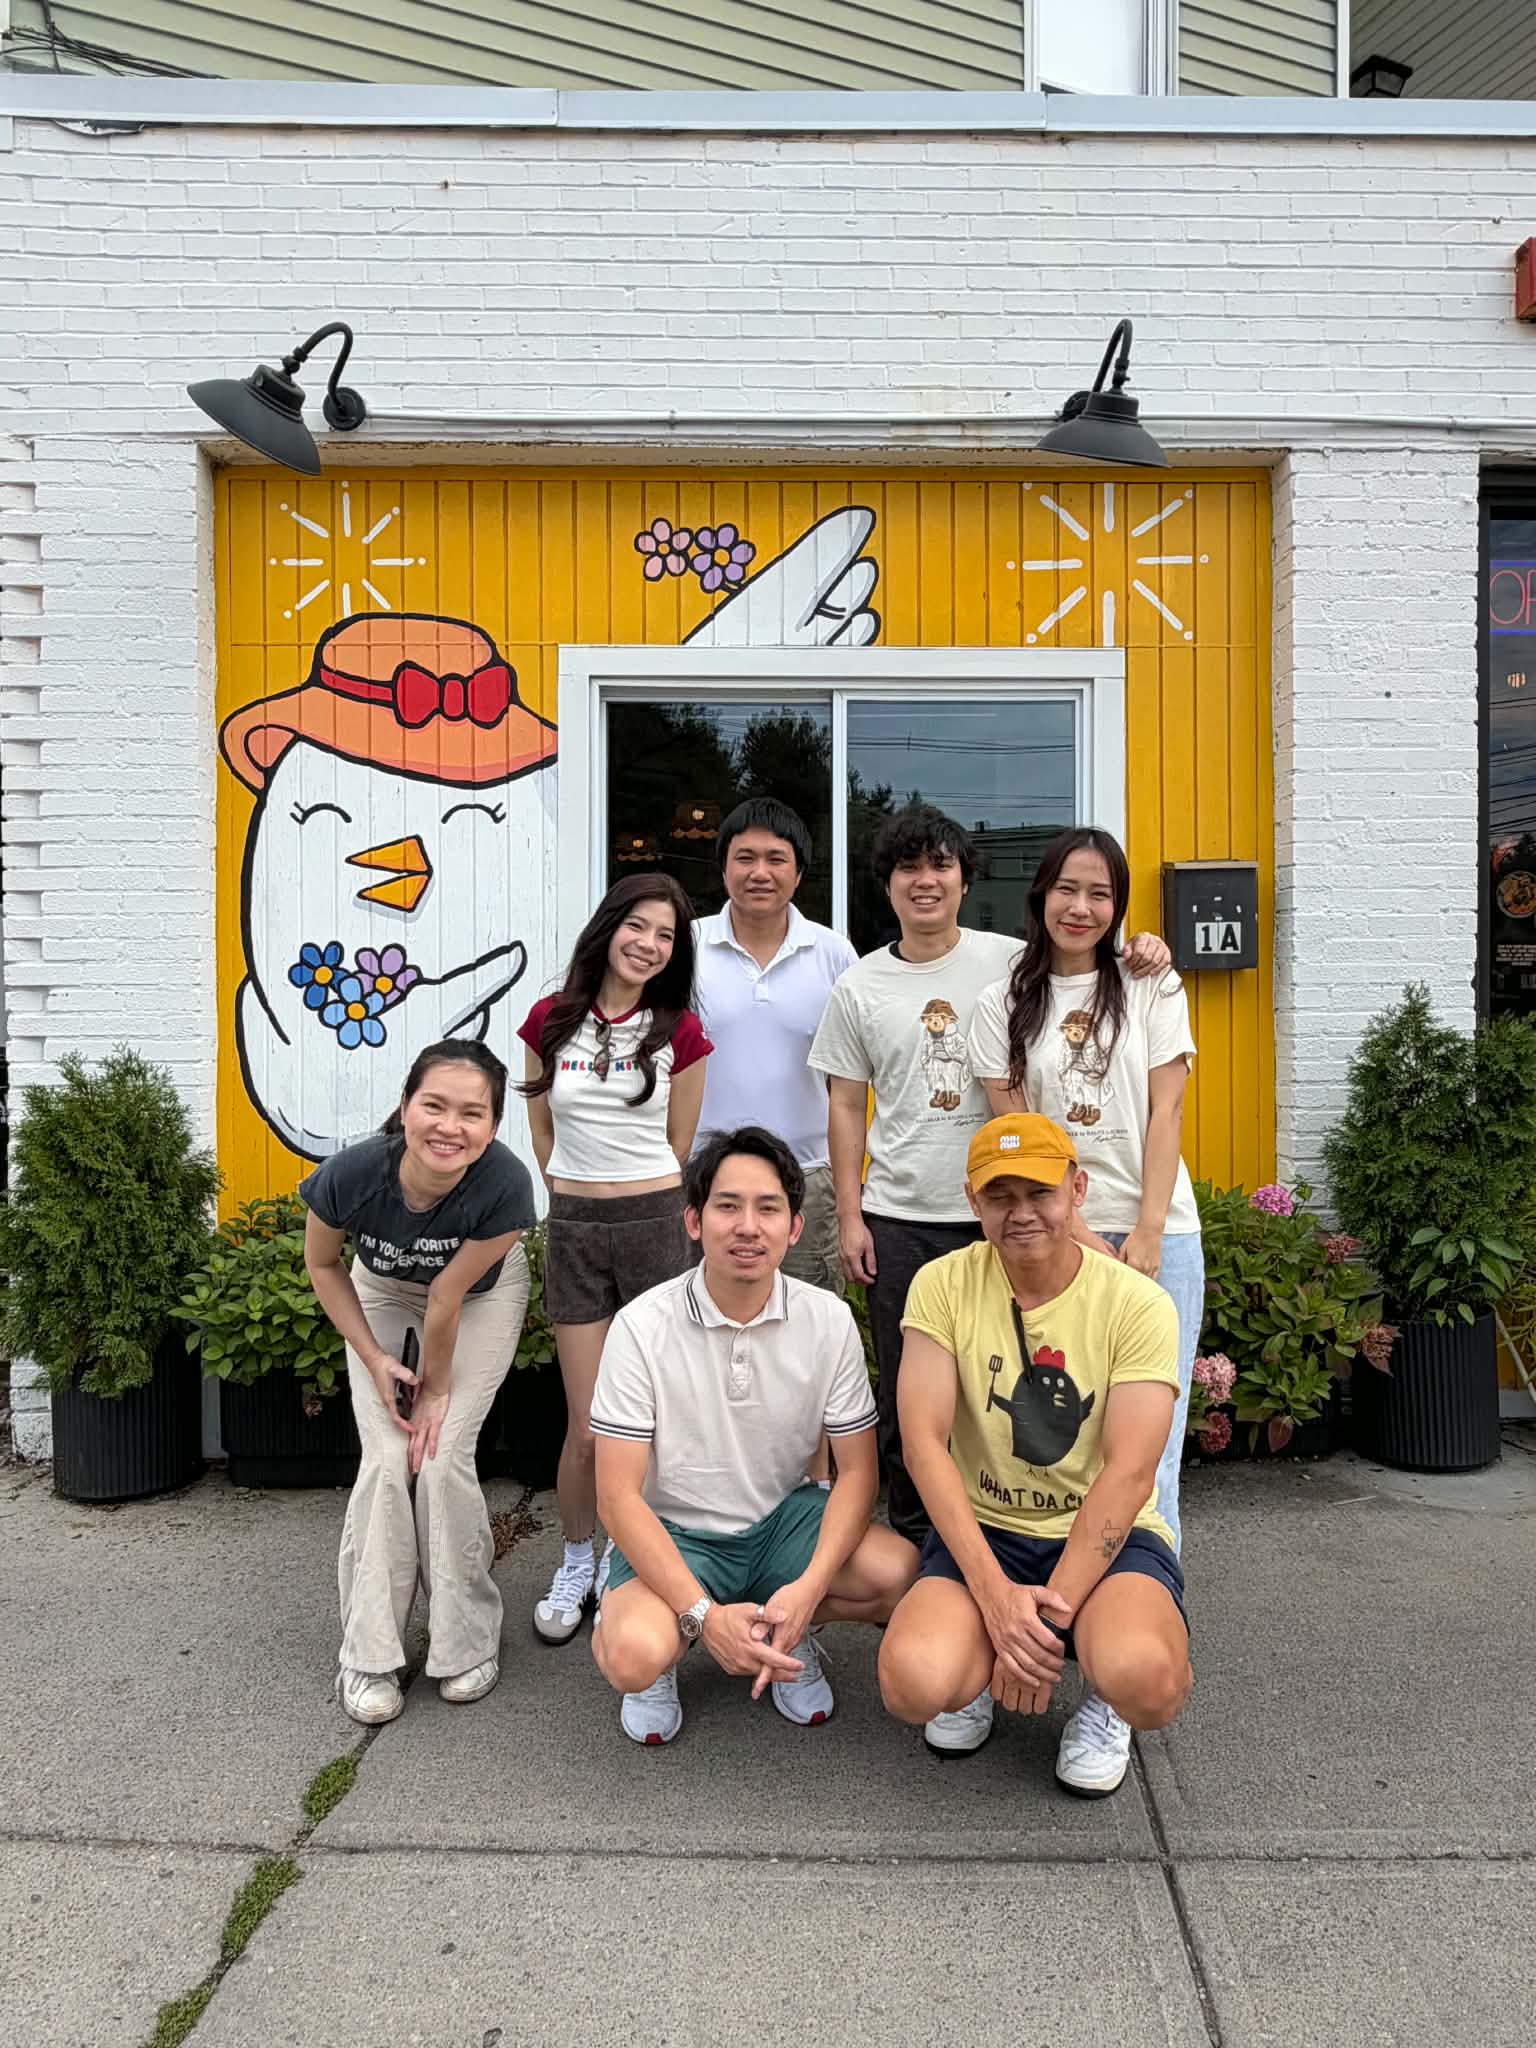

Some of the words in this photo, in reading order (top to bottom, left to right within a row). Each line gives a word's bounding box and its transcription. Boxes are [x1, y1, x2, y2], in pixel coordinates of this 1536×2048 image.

[1201, 924, 1239, 952] 1A
[360, 1233, 376, 1249] I'M
[413, 1237, 460, 1252] VORITE
[980, 1469, 1026, 1507] WHAT
[1032, 1490, 1058, 1509] DA
